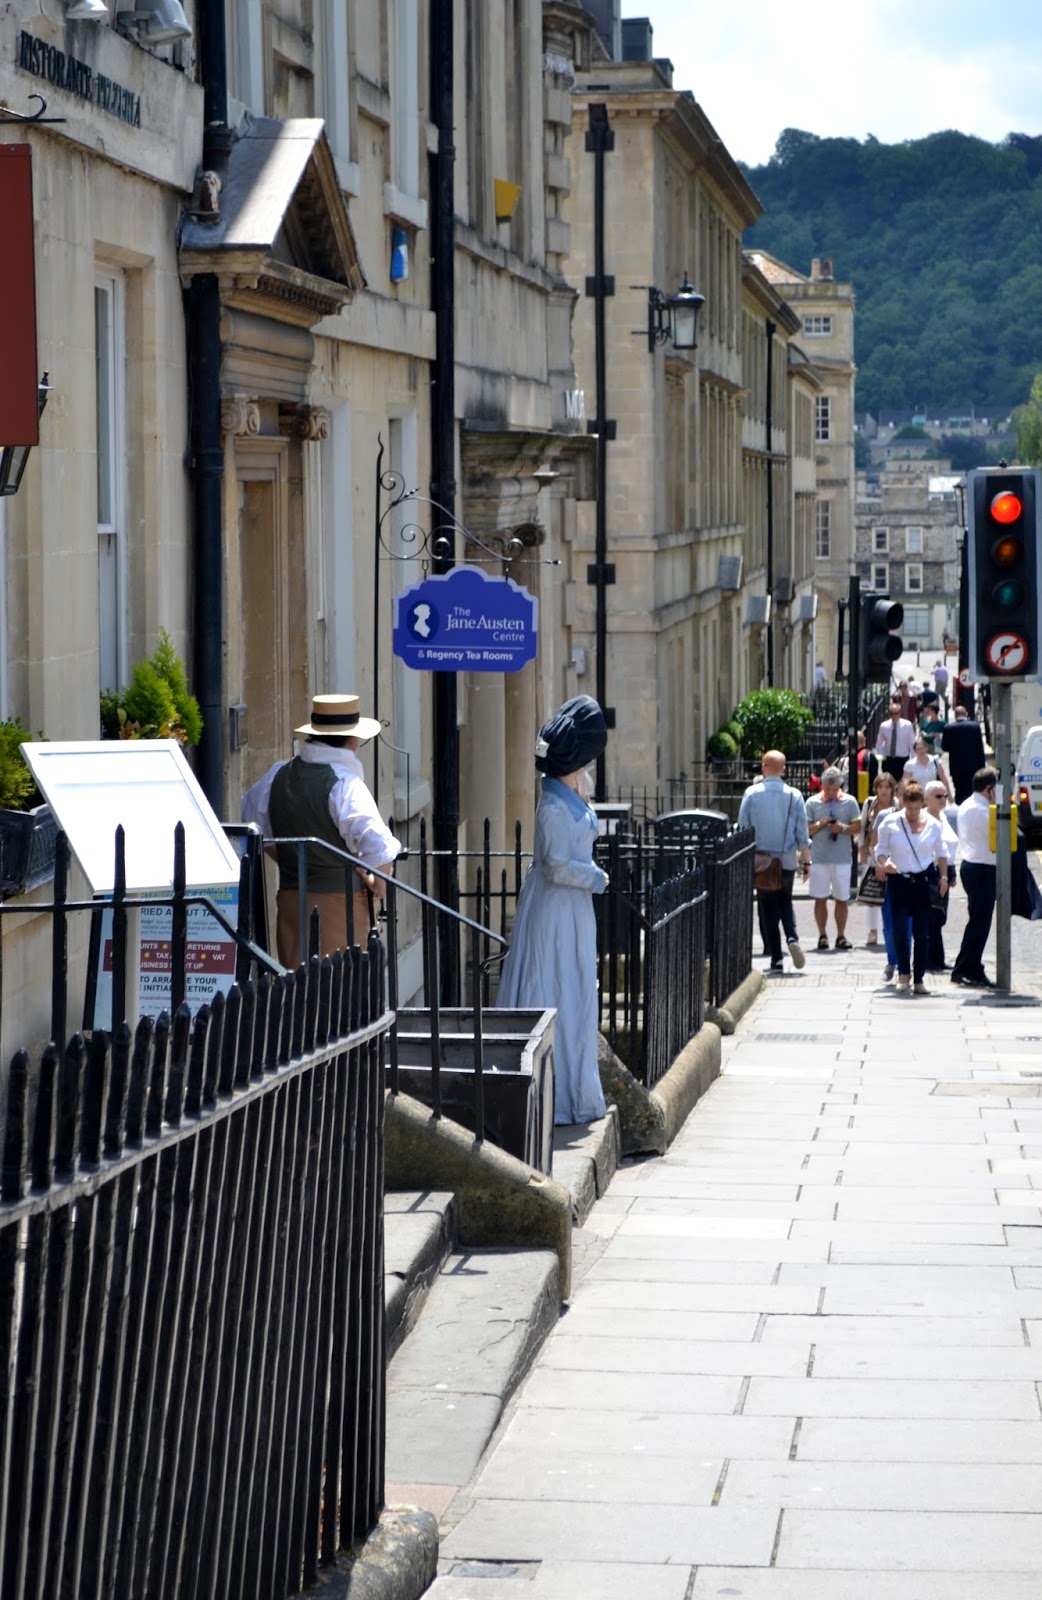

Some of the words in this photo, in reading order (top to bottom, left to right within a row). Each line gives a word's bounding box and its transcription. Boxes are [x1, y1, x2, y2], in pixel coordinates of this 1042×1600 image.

[20, 29, 92, 100] RISTORANTE
[97, 72, 141, 129] PIZZERIA
[454, 606, 470, 617] The
[446, 614, 476, 631] Jane
[476, 615, 525, 630] Austen
[492, 631, 525, 642] Centre
[417, 650, 425, 659] &
[426, 650, 464, 661] Regency
[465, 651, 481, 660] Tea
[483, 651, 513, 661] Rooms
[140, 907, 163, 916] RIED
[165, 907, 199, 917] AUT
[187, 943, 221, 952] RETURNS
[152, 976, 192, 984] ARRAE
[195, 977, 217, 985] YOUR
[185, 985, 214, 993] ETING
